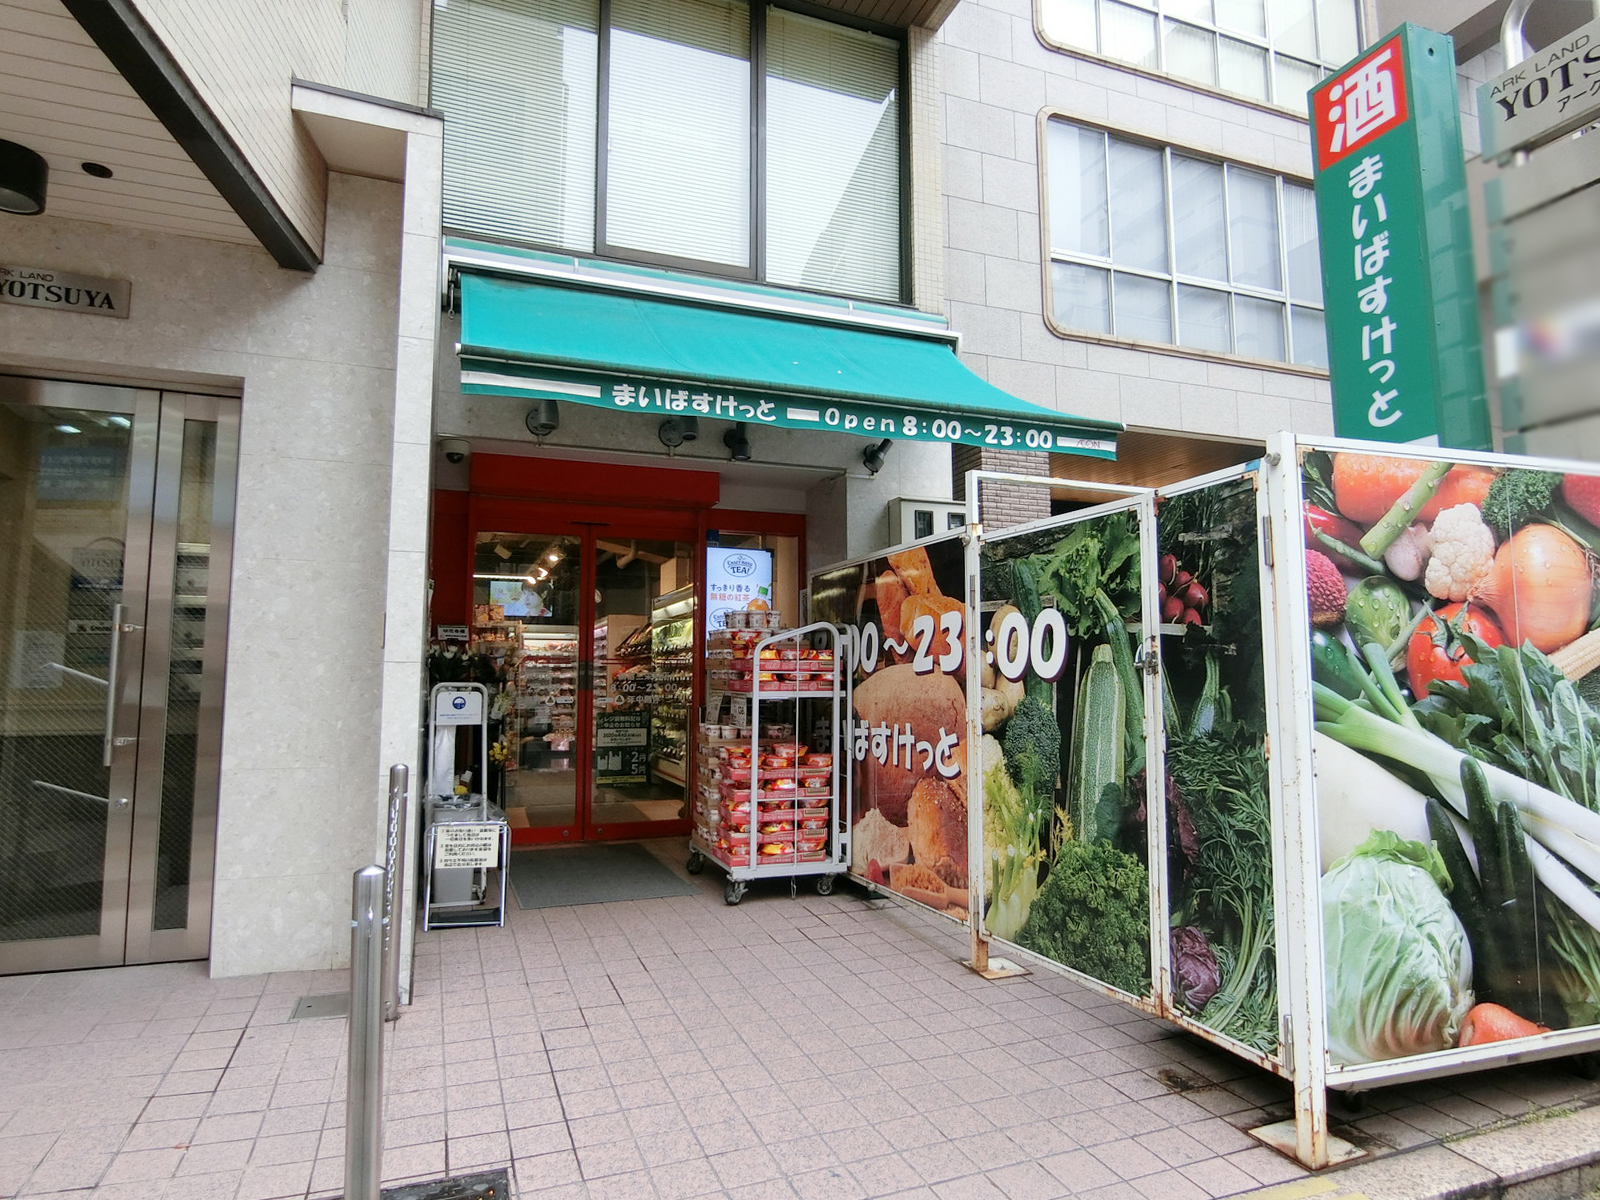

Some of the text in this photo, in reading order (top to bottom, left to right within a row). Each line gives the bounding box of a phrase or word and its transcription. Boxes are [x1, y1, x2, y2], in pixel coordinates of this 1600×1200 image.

[1490, 35, 1589, 98] ARK LAND
[1328, 48, 1397, 153] 酒
[20, 271, 54, 282] LAND
[1348, 154, 1402, 428] まいばすけっと
[611, 384, 777, 421] まいばすけっと
[824, 408, 895, 432] Open
[730, 566, 750, 574] TEA!
[711, 584, 751, 592] すっきり香る
